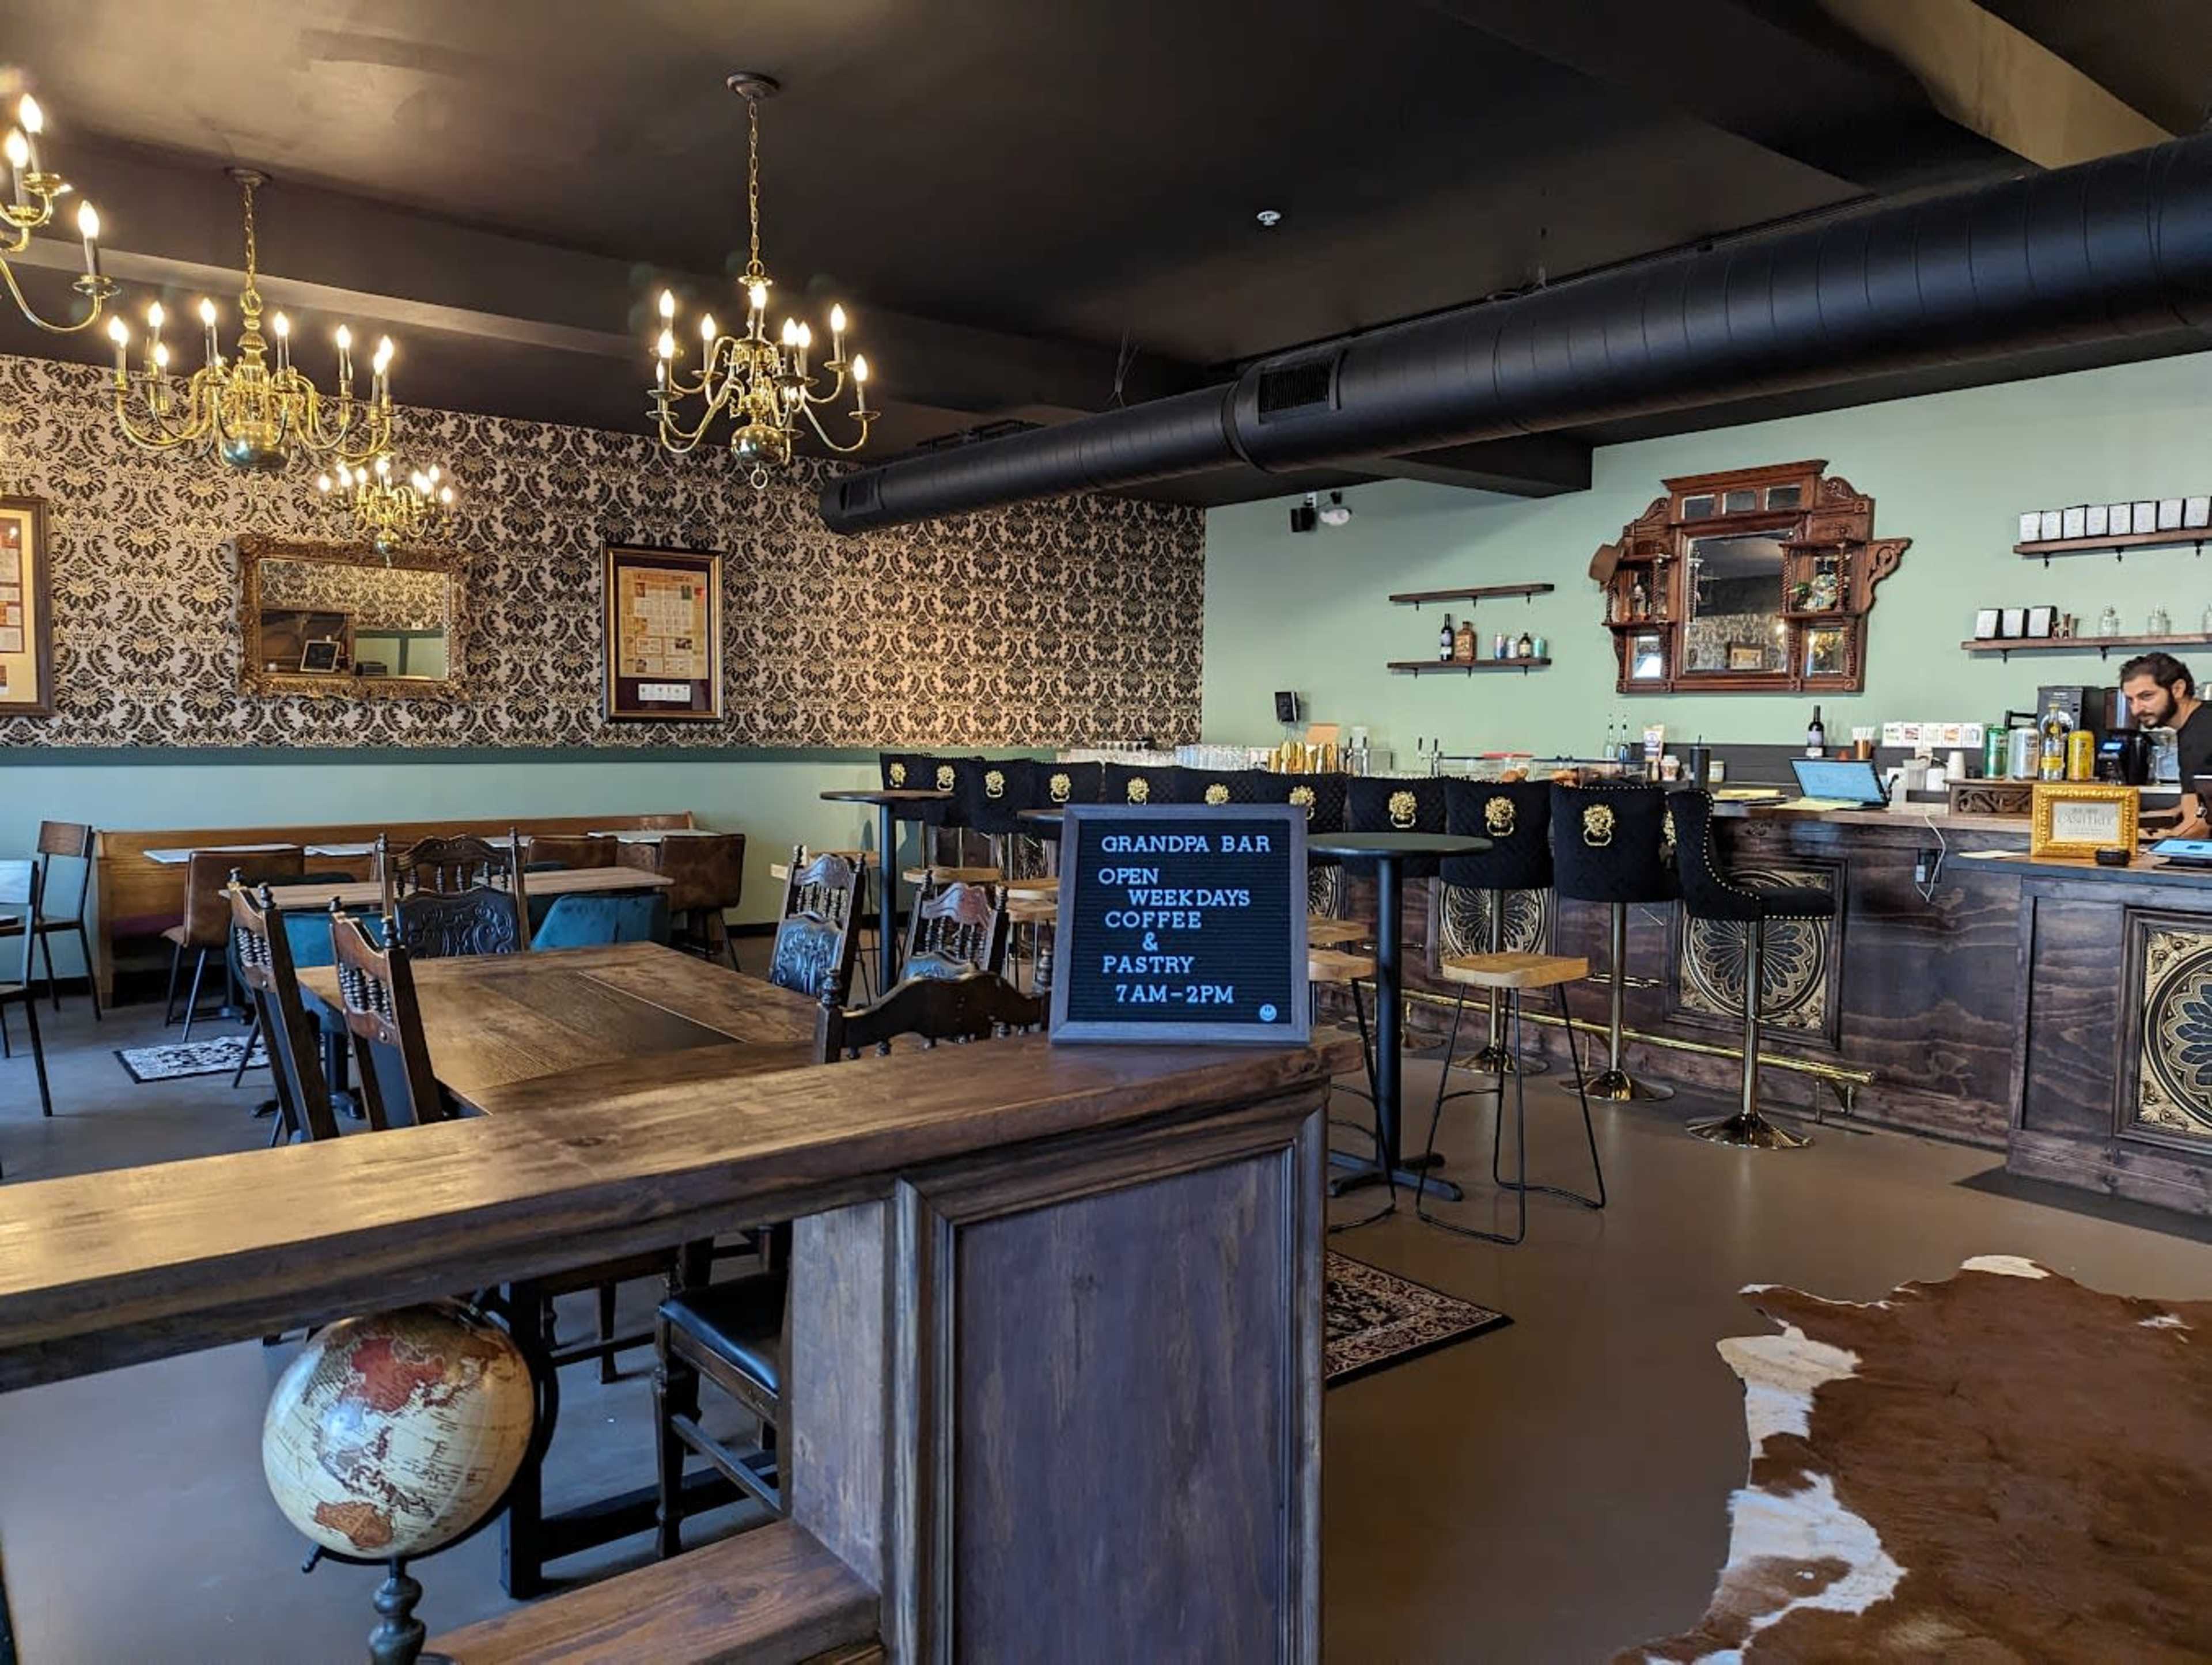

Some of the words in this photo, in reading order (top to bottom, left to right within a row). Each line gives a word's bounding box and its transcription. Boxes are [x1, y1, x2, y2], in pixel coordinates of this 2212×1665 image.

[1101, 835, 1210, 853] GRANDPA
[1221, 835, 1271, 853] BAR
[1098, 867, 1159, 885] OPEN
[1127, 889, 1251, 907] WEEKDAYS
[1104, 911, 1202, 929] COFFEE
[1142, 931, 1158, 952] &
[1102, 955, 1195, 974] PASTRY
[1115, 984, 1234, 1004] 7AM-2PM
